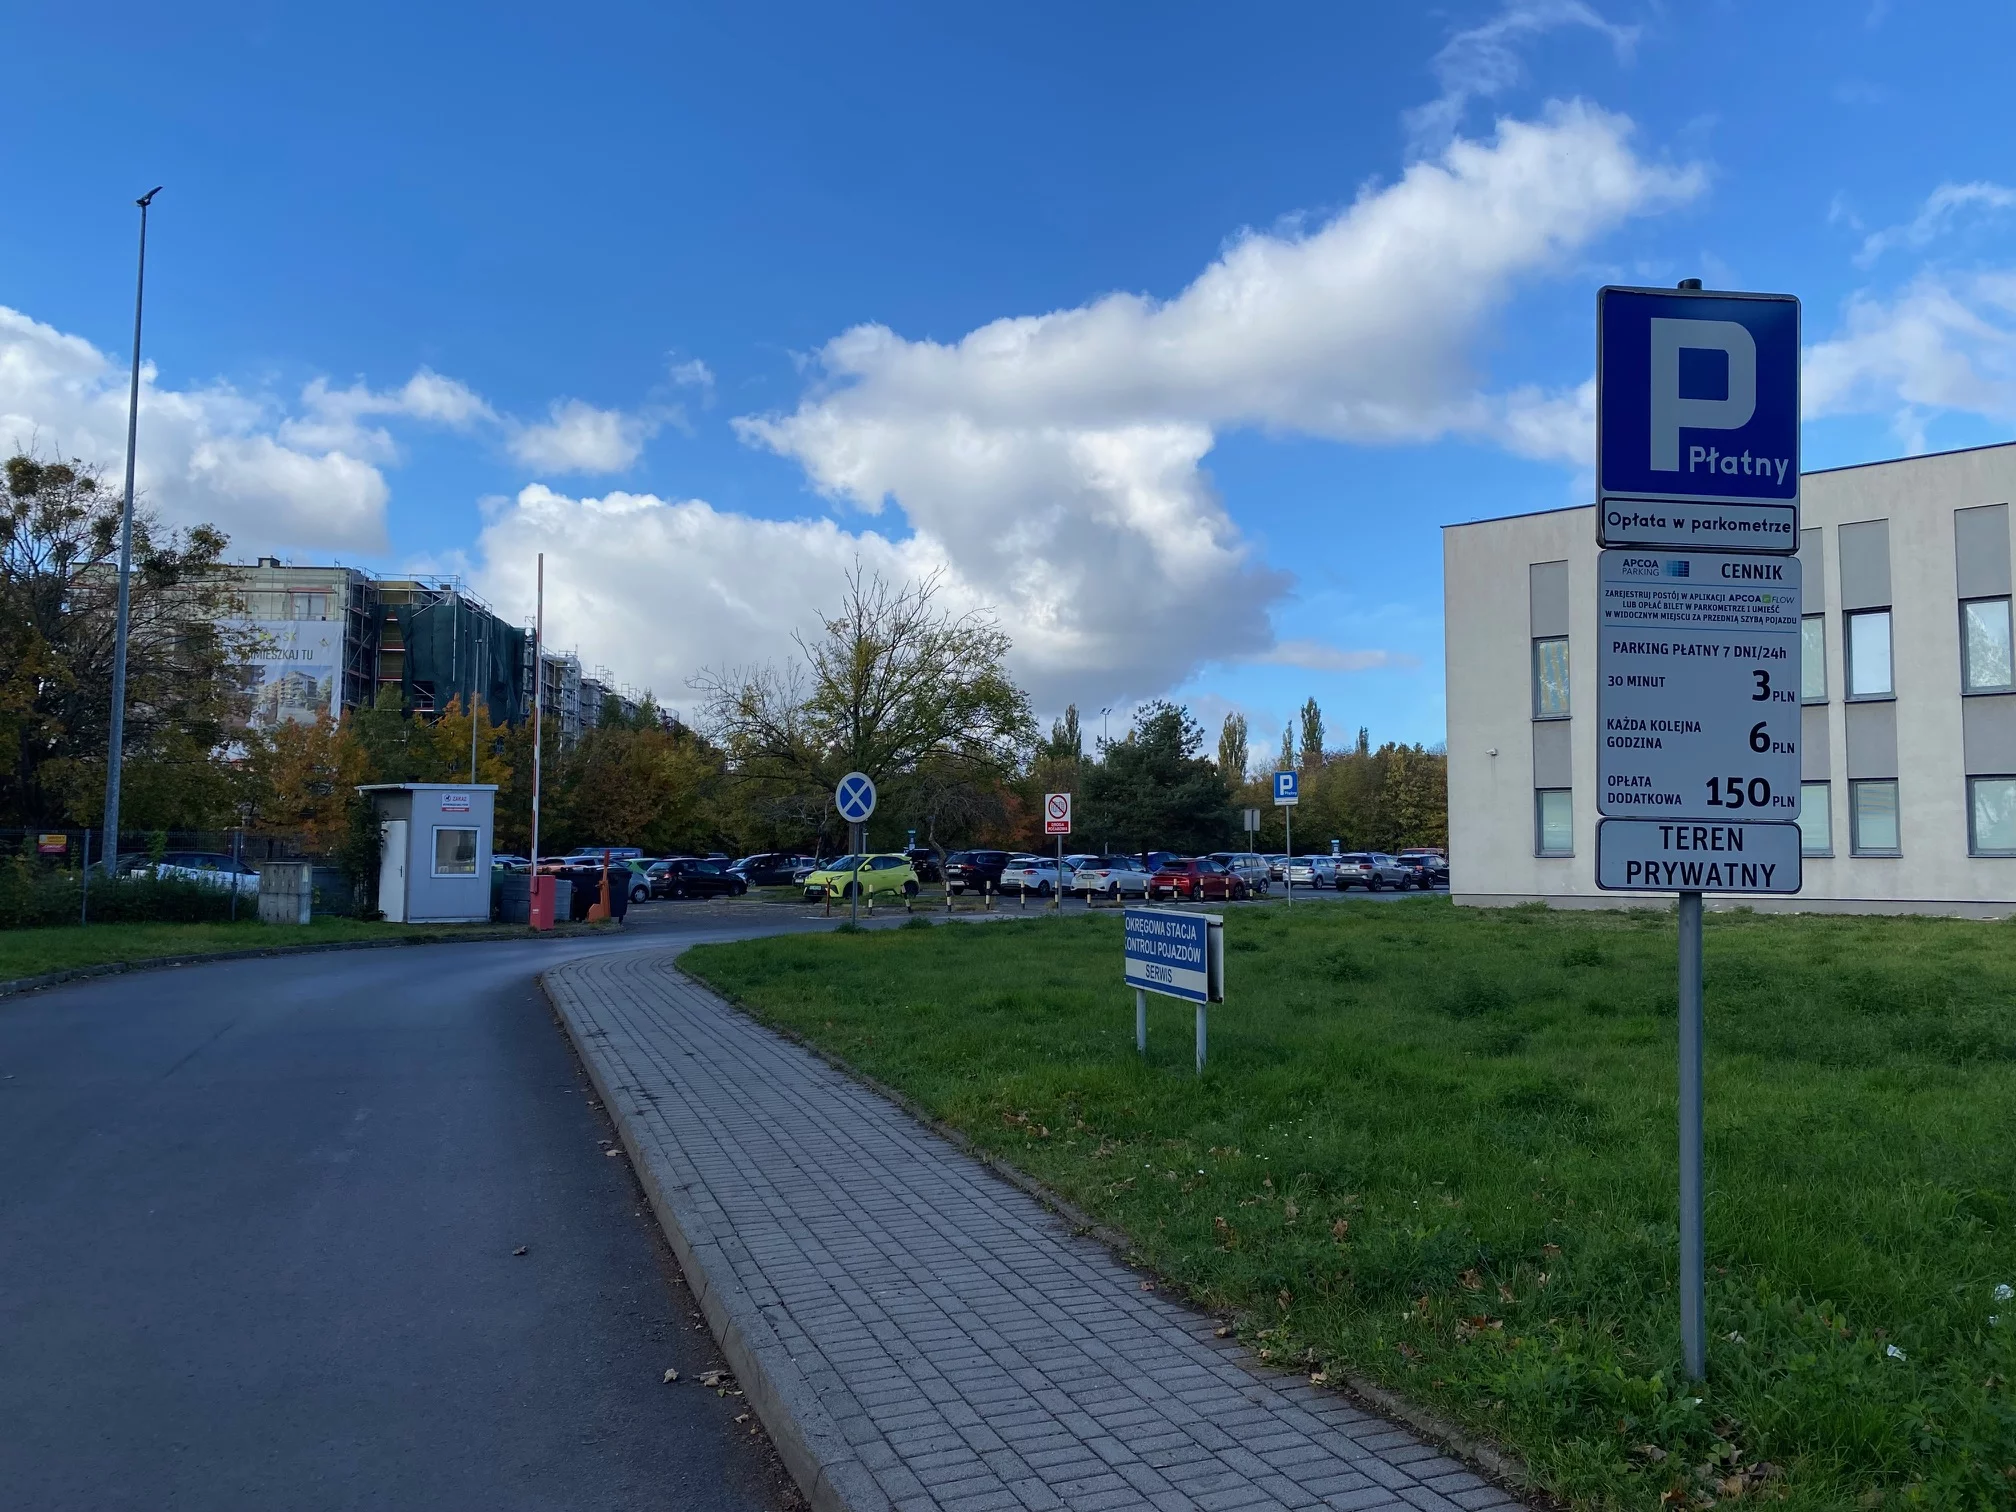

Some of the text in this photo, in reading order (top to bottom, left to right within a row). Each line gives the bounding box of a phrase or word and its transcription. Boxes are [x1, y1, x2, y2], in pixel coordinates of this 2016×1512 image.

[1651, 318, 1756, 471] P
[1690, 446, 1789, 485] Płatny
[1608, 512, 1791, 533] Opłata w parkometrze
[1622, 567, 1659, 576] PARKING
[1623, 559, 1659, 568] APCOA
[1722, 563, 1783, 580] CENNIK
[1605, 590, 1652, 599] ZAREJESTRUJ
[1653, 590, 1680, 600] POSTÓJ
[1690, 593, 1726, 602] APLIKACJI
[1729, 594, 1761, 603] APCOA
[1772, 596, 1795, 604] FLOW
[1638, 600, 1662, 609] OPŁAĆ
[1663, 602, 1684, 610] BILET
[1693, 604, 1745, 613] PARKOMETRZE
[1752, 604, 1780, 613] UMIEŚĆ
[1605, 610, 1797, 625] W WIDOCZNYM MIEJSCU ZA PRZEDNIĄ SZYBĄ POJAZDU
[302, 649, 313, 660] TU
[1613, 642, 1787, 660] PARKING PŁATNY 7 DNI/24h
[1608, 676, 1666, 687] 30 MINUT
[1607, 716, 1701, 734] KAŻDA KOLEJNA
[1607, 736, 1662, 749] GODZINA
[1280, 775, 1293, 795] P
[1608, 775, 1652, 787] OPŁATA
[1608, 792, 1682, 805] DODATKOWA
[1659, 826, 1743, 852] TEREN
[1627, 860, 1776, 888] PRYWATNY
[1125, 916, 1197, 940] OKRĘGOWA STACJA
[1157, 943, 1201, 963] POJAZDÓW
[1145, 964, 1173, 983] SERWIS
